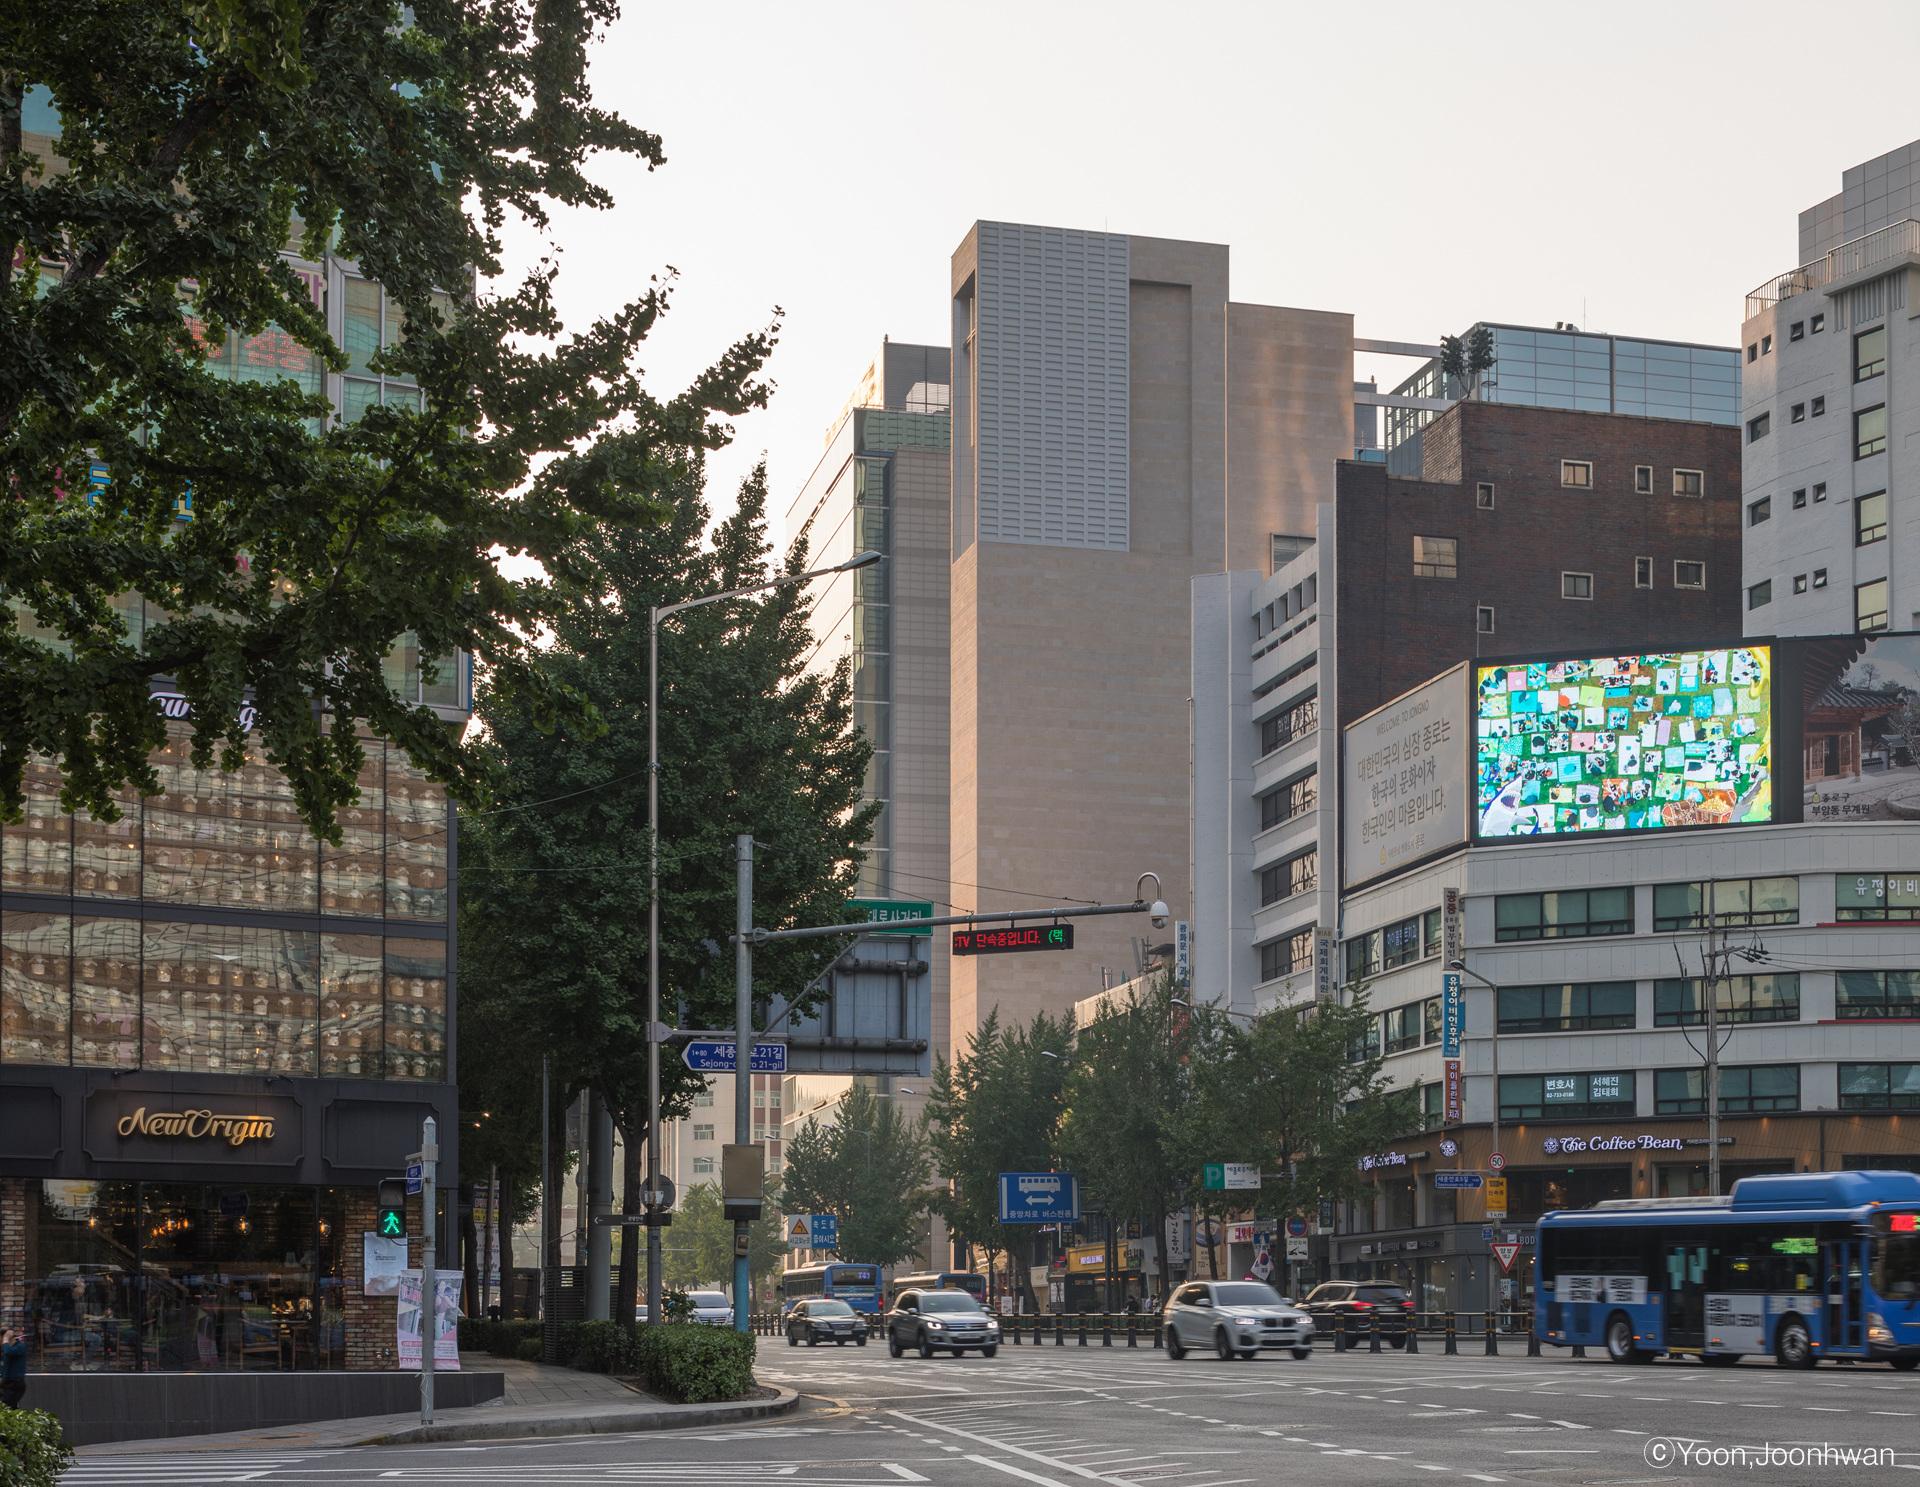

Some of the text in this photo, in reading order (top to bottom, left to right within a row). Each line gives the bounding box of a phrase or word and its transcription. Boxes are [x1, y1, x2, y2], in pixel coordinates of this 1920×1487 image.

[1376, 700, 1430, 737] WELCOME TO JONGNO
[1358, 718, 1451, 782] 대한민국의 심장 종로는
[1371, 755, 1437, 808] 한국의 문화이자
[1822, 792, 1850, 803] 종로구
[1361, 784, 1447, 844] 한국인의 마음입니다.
[1811, 804, 1870, 816] 부암동 무계원
[1855, 877, 1918, 898] 유정이비
[1446, 890, 1457, 915] 공증
[975, 929, 1041, 948] 단속중입니다.
[1319, 938, 1329, 994] 국제회계학원
[1448, 976, 1459, 1047] 유정이비인후과
[713, 1045, 783, 1060] 세종로21길
[700, 1059, 783, 1070] Sejong-o 21-gil
[1546, 1079, 1575, 1091] 변호사
[1592, 1075, 1619, 1087] 서혜진
[1559, 1137, 1587, 1153] The
[1589, 1136, 1636, 1151] Coffee
[1636, 1135, 1684, 1151] Bean
[1492, 1156, 1503, 1167] 50
[1206, 1166, 1220, 1188] P
